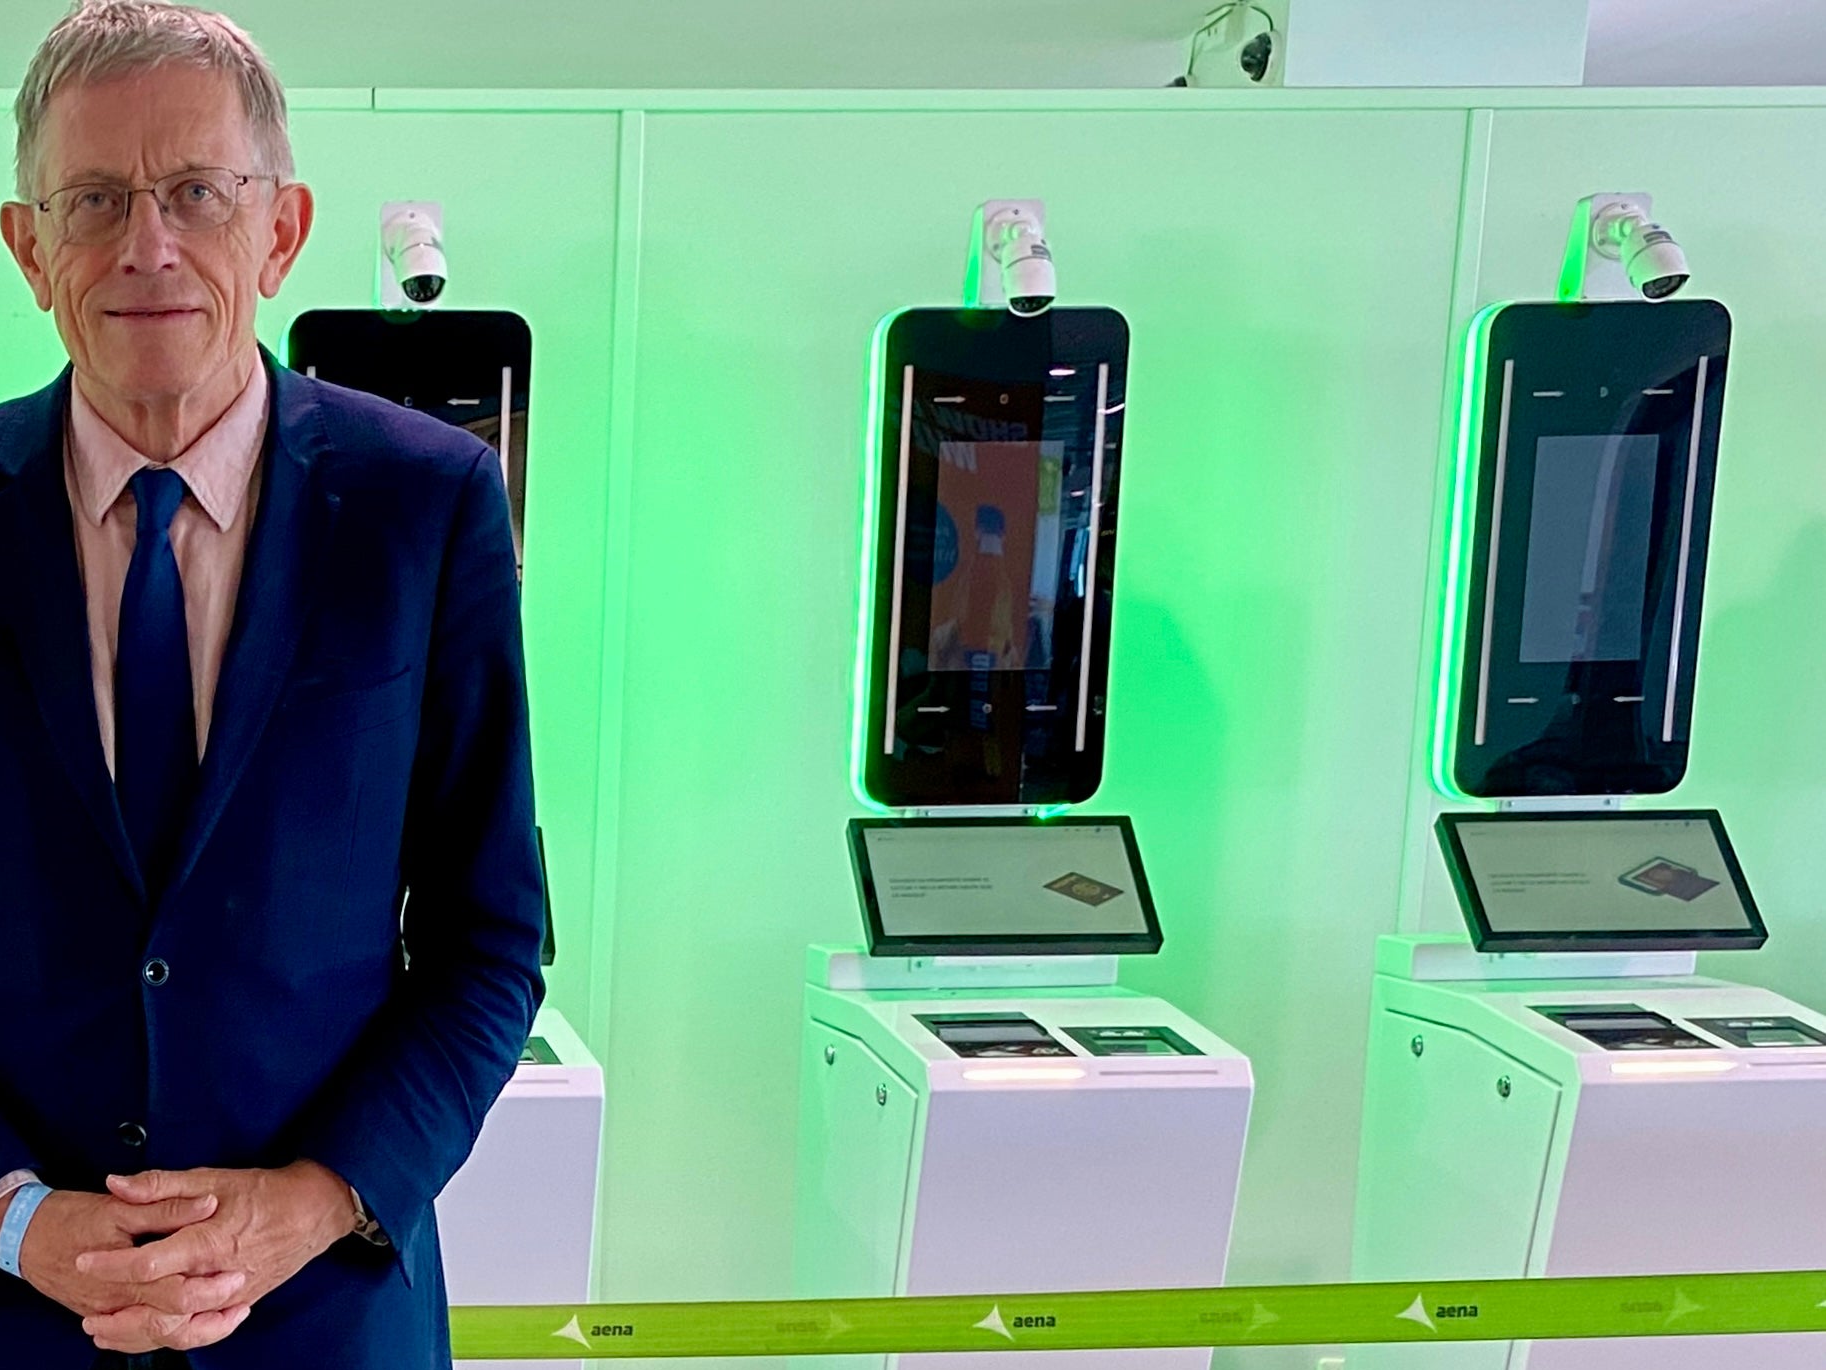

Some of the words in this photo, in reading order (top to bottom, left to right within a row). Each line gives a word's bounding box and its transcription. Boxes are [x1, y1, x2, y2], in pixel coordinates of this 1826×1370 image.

[1436, 1305, 1479, 1318] aena
[1013, 1315, 1057, 1328] aena
[591, 1325, 634, 1336] aena
